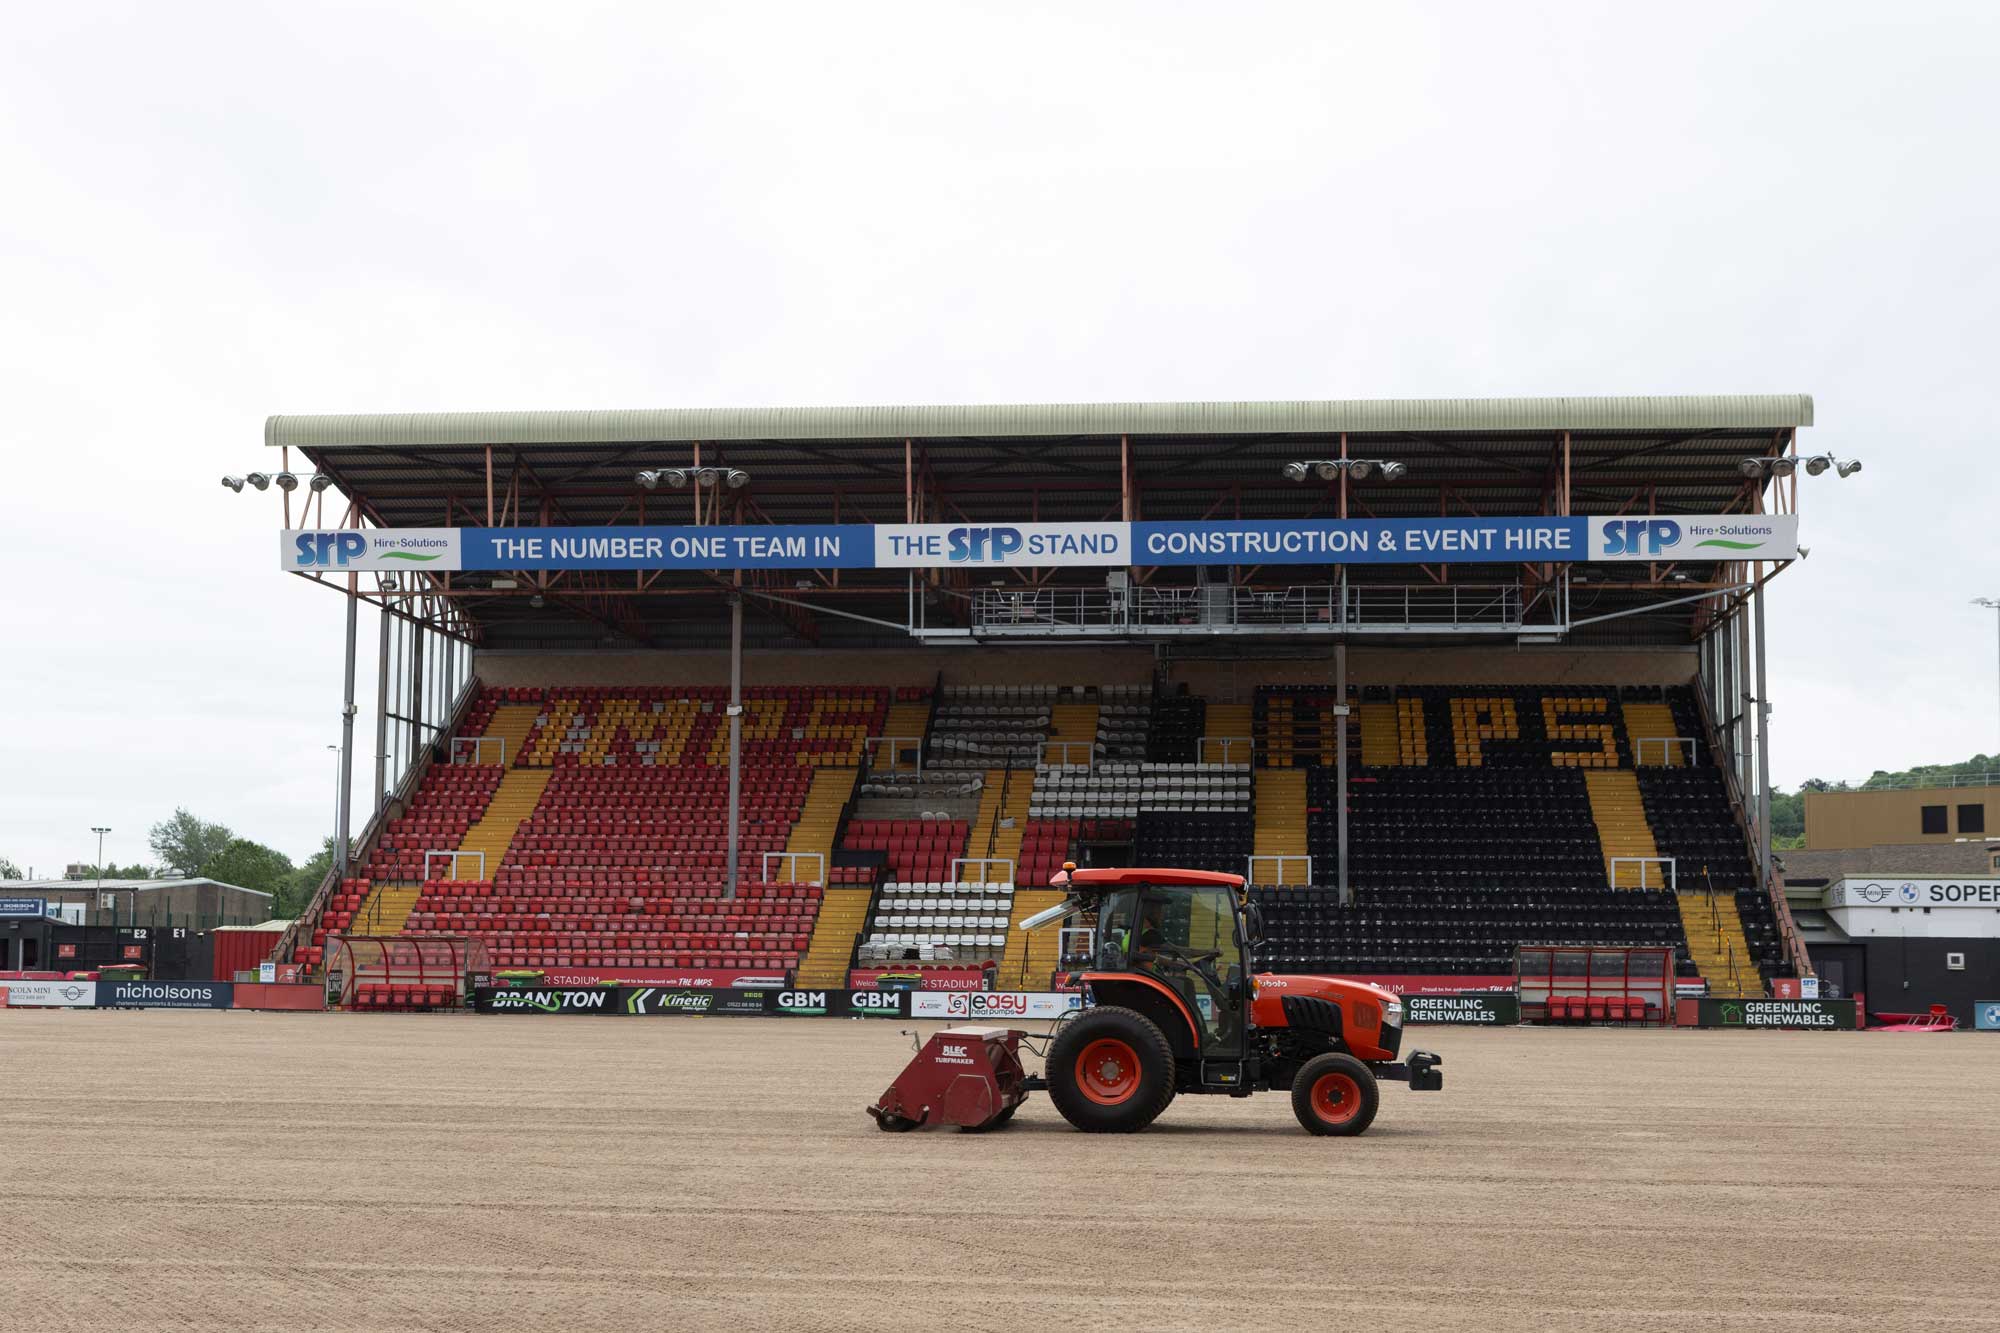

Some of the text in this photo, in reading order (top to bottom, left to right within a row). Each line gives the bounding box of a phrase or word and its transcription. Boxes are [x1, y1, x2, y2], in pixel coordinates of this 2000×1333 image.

[888, 535, 942, 556] THE
[1028, 533, 1119, 555] STAND
[1147, 527, 1571, 554] CONSTRUCTION & EVENT HIRE
[491, 536, 840, 560] THE NUMBER ONE TEAM IN
[133, 928, 147, 939] E2
[173, 928, 186, 938] E1
[553, 976, 600, 985] STADIUM
[678, 977, 692, 986] THE
[930, 979, 978, 988] STADIUM
[1258, 979, 1288, 988] ubota
[8, 986, 51, 994] NCOLN MINI
[116, 982, 213, 1000] nicholsons
[1378, 984, 1404, 993] DIUM
[491, 991, 606, 1011] BRANSTON
[658, 993, 710, 1006] Kinetic
[777, 991, 826, 1007] GBM
[851, 991, 899, 1008] GBM
[972, 993, 1027, 1015] easy
[1410, 999, 1483, 1010] GREENLINC
[989, 1008, 1016, 1016] pumps
[1745, 1002, 1822, 1013] GREENLINC
[1410, 1011, 1496, 1021] RENEWABLES
[1746, 1014, 1835, 1025] RENEWABLES
[942, 1045, 967, 1057] BLEC
[935, 1056, 974, 1065] TURFMAKER
